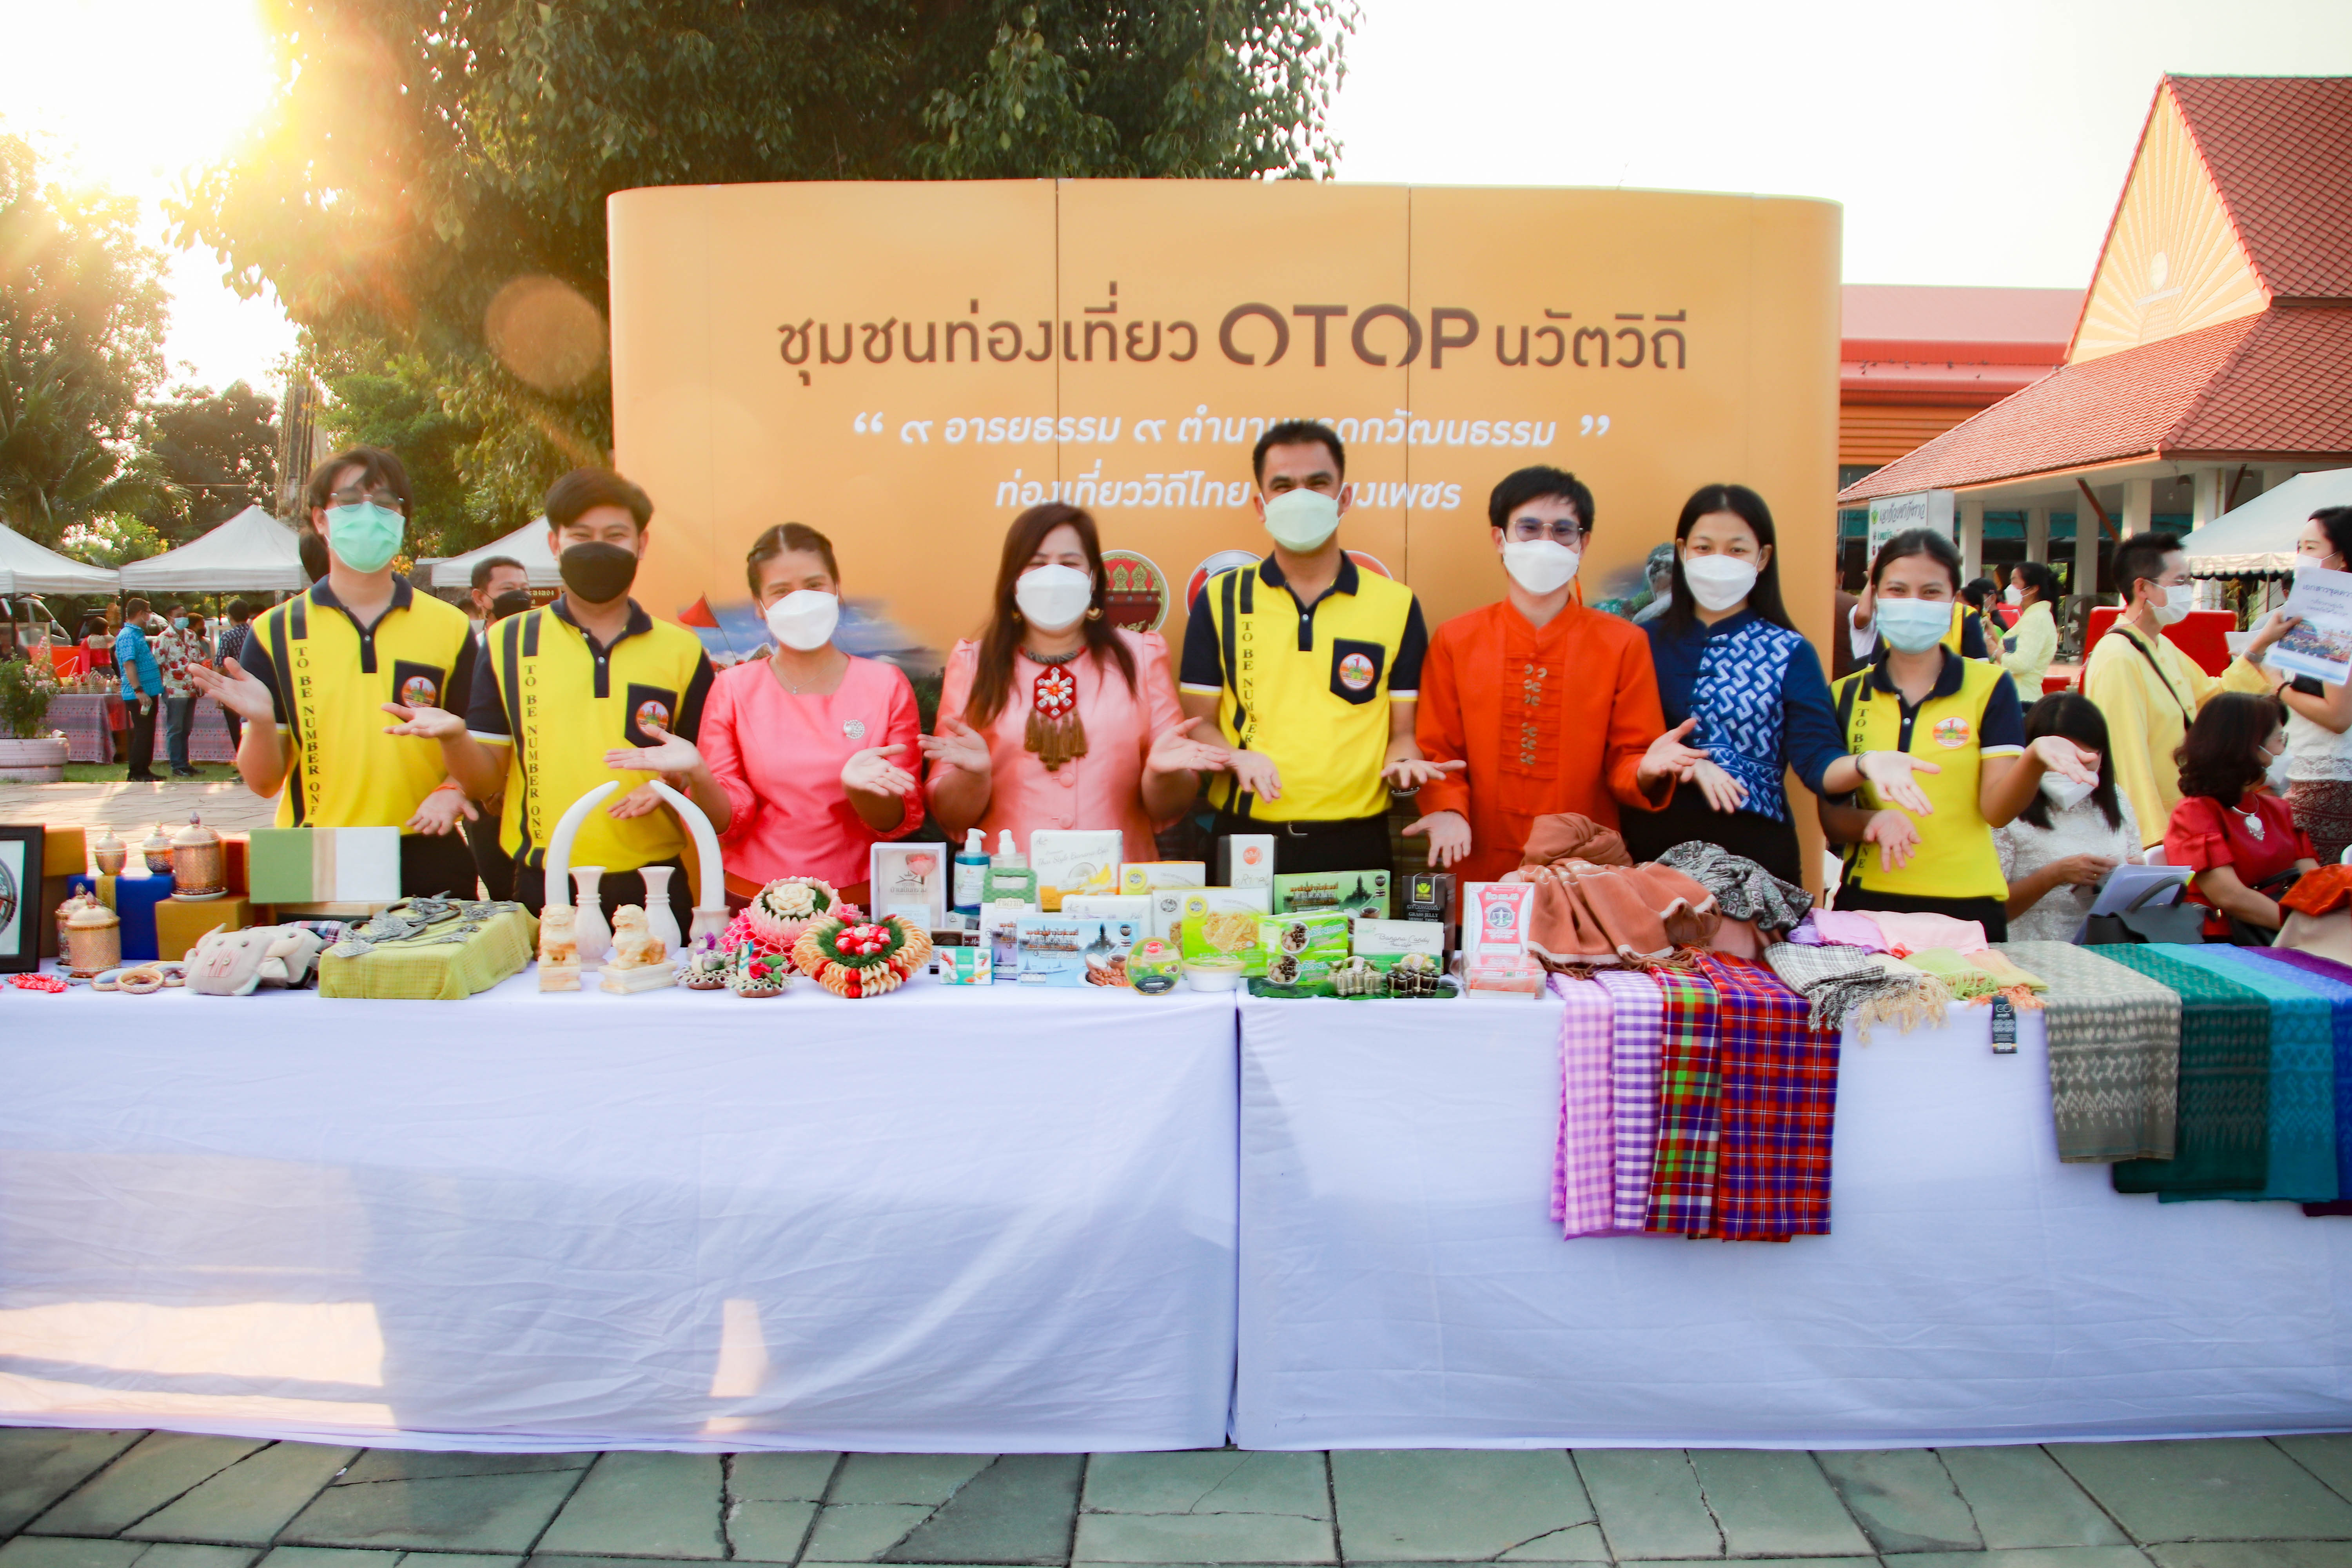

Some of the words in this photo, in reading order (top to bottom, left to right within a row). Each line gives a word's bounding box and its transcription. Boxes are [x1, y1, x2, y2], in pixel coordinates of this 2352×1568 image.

[778, 281, 1198, 386] ชุมชนท่องเที่ยว
[1218, 302, 1480, 369] OTOP
[1496, 309, 1687, 369] นวัตวิถี
[944, 416, 1122, 444] อารยธรรม
[1242, 621, 1253, 642] TO
[295, 647, 309, 668] TO
[1242, 649, 1253, 670] BE
[300, 676, 313, 698] BE
[525, 665, 537, 687] TO
[526, 695, 537, 717] BE
[1855, 708, 1869, 728] TO
[303, 705, 320, 775] NUMBER
[1853, 733, 1864, 755] BE
[527, 725, 539, 798] NUMBER
[309, 782, 320, 815] ONE
[530, 805, 543, 839] ONE
[1408, 935, 1430, 944] Candy
